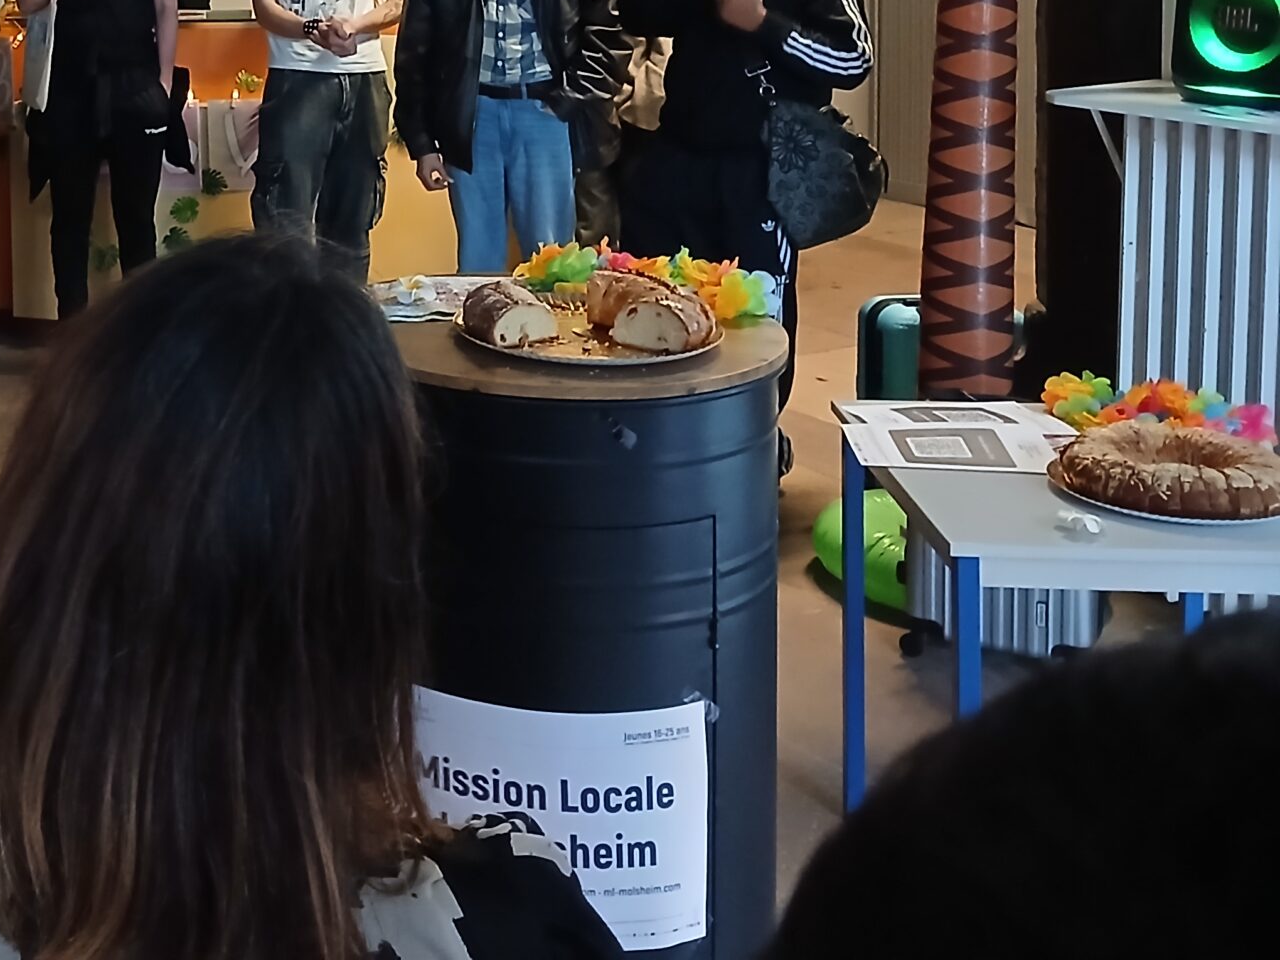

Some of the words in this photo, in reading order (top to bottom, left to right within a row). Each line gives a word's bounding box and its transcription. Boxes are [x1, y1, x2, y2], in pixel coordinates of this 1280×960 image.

[623, 731, 652, 742] Jeunes
[417, 750, 547, 810] Mission
[560, 775, 675, 814] Locale
[569, 833, 657, 869] heim
